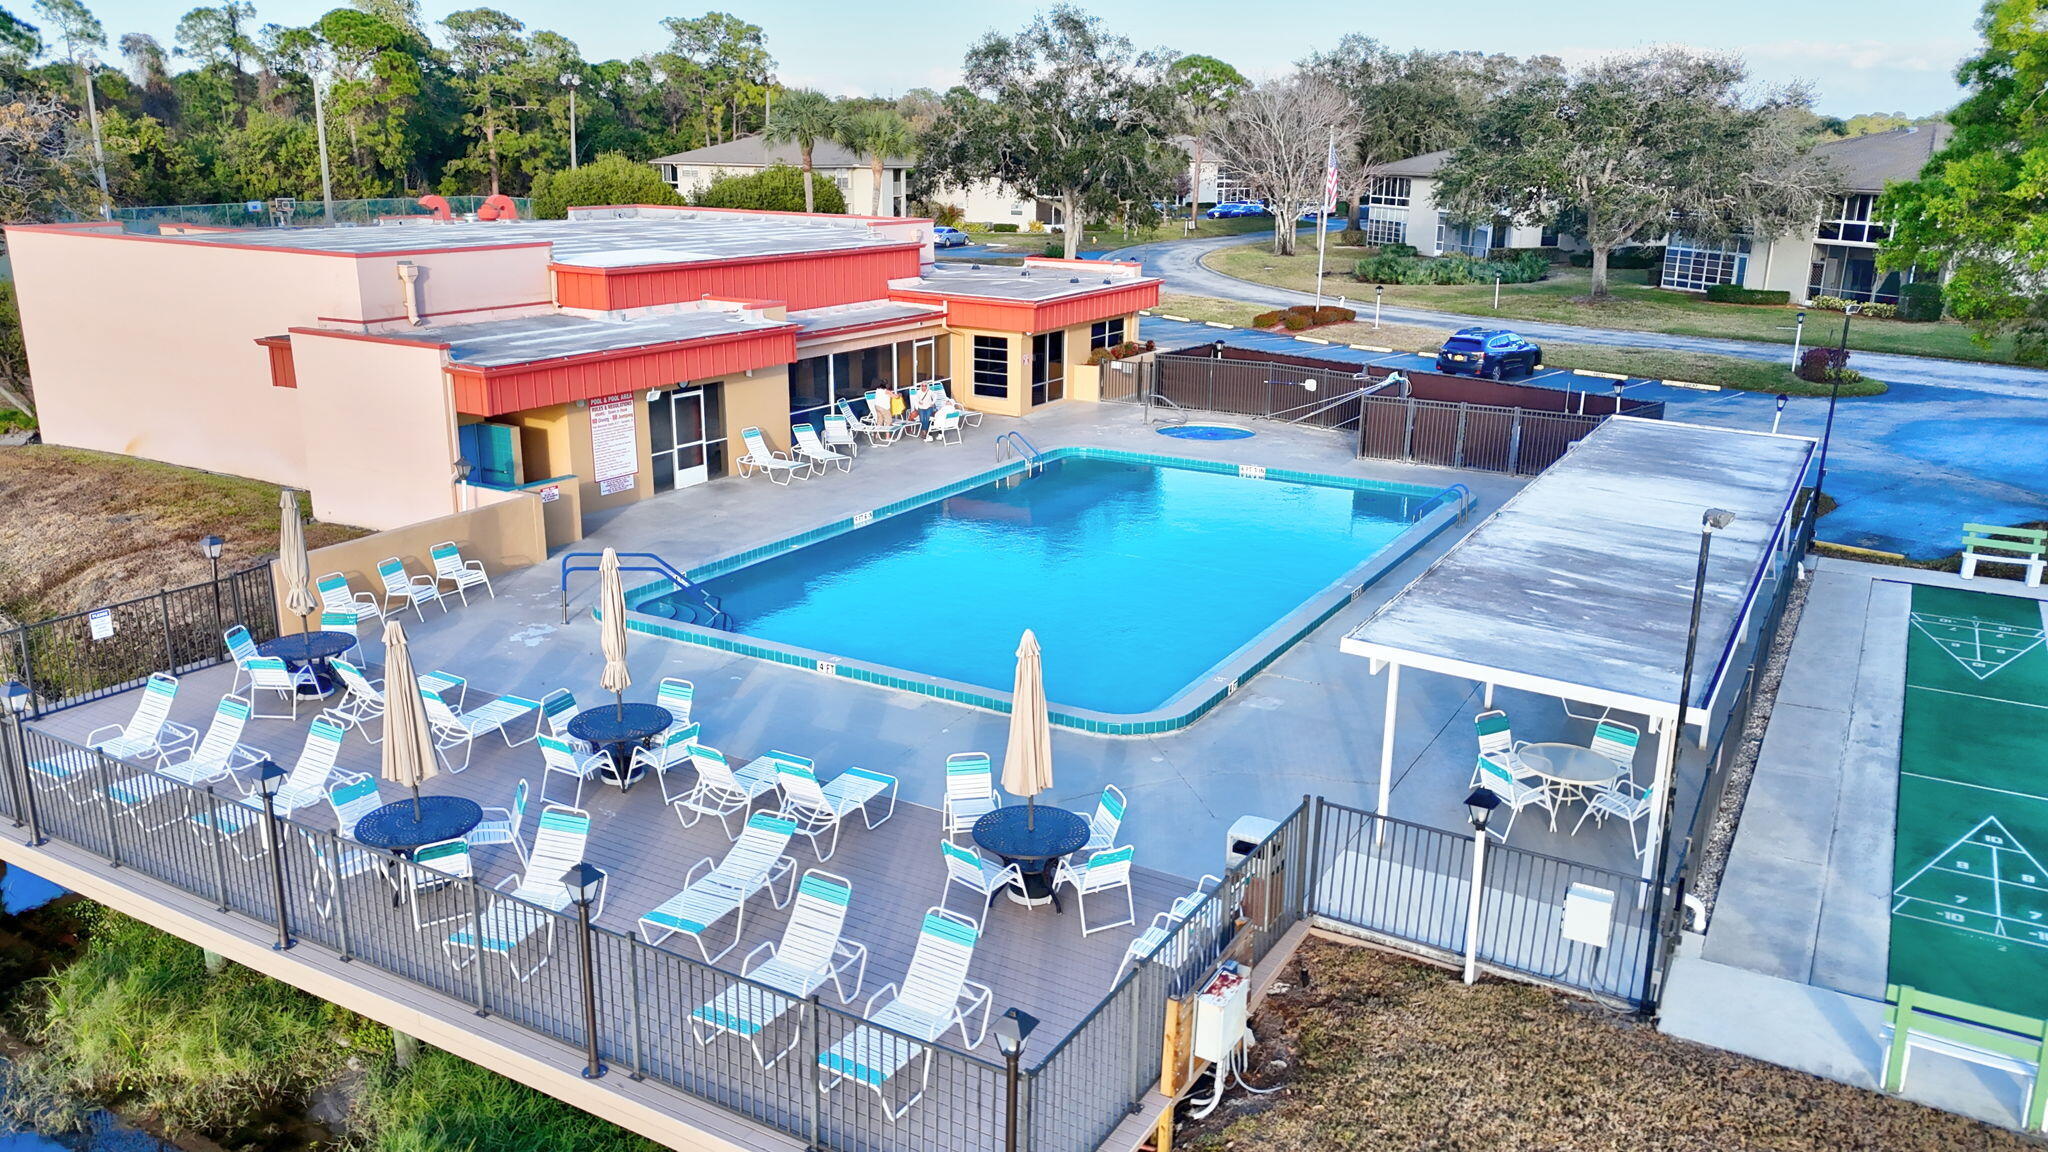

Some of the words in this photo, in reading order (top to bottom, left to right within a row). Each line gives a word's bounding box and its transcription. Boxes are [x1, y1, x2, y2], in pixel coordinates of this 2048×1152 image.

[608, 401, 632, 409] REGULATIONS
[826, 664, 834, 673] FT
[1985, 835, 2003, 845] 10
[1956, 861, 1969, 870] 8
[2021, 874, 2036, 884] 8
[1955, 894, 1968, 903] 7
[1936, 911, 1966, 923] -10
[2028, 911, 2042, 920] 7
